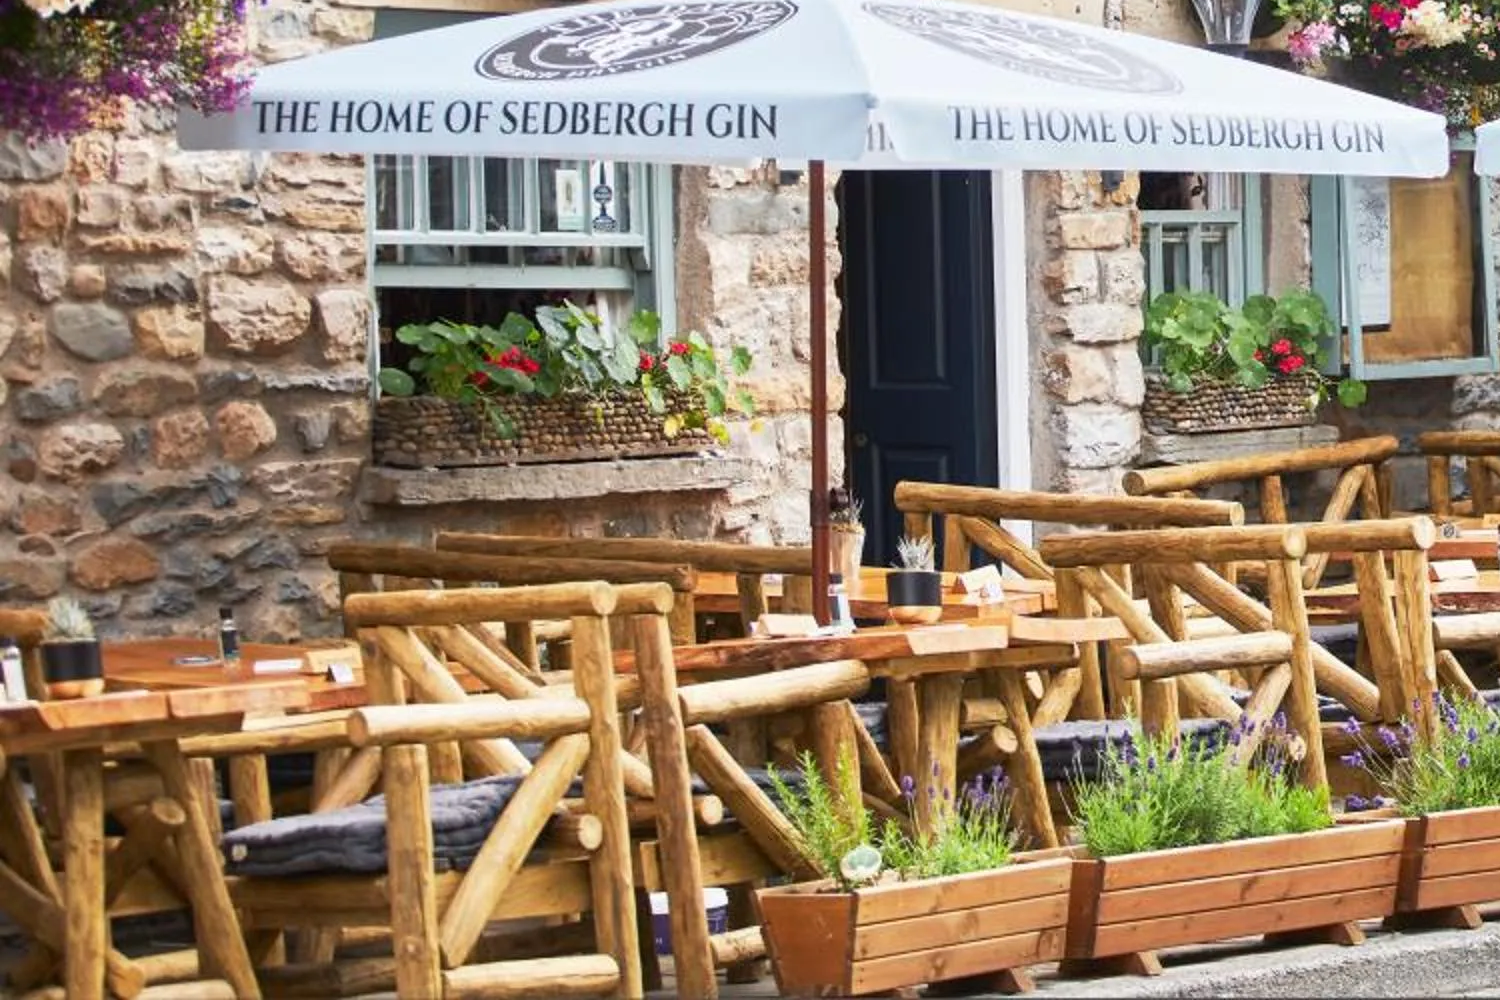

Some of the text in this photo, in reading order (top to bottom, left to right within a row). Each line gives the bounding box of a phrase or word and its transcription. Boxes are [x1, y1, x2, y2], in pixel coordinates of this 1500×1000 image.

[254, 101, 777, 139] THE HOME OF SEDBERGH GIN
[948, 105, 1385, 153] THE HOME OF SEDBERGH GIN
